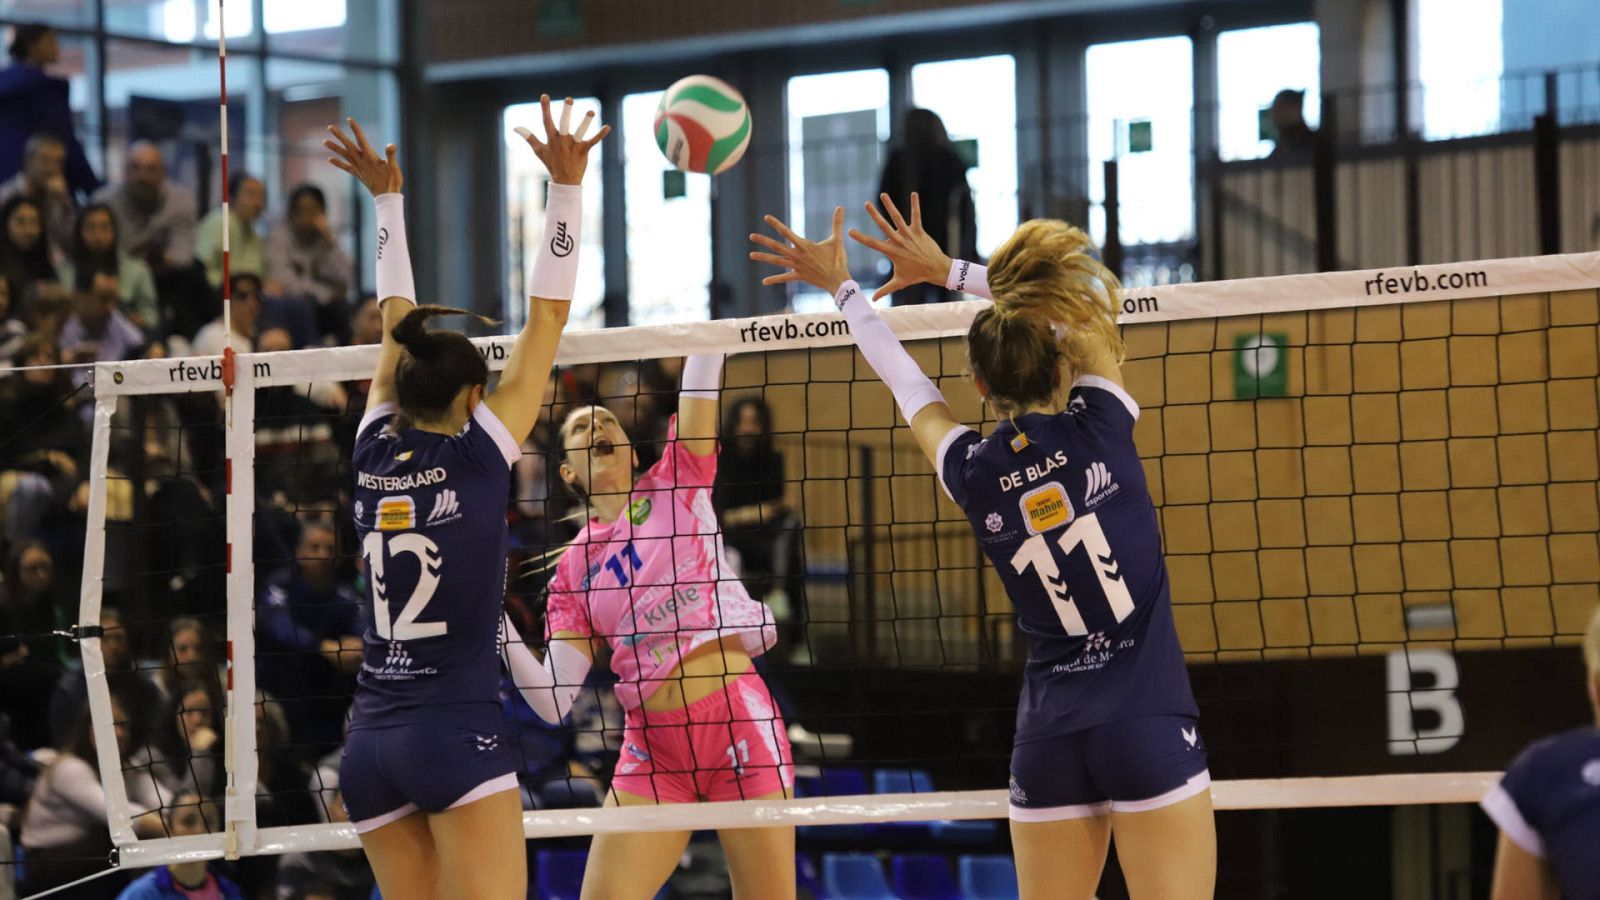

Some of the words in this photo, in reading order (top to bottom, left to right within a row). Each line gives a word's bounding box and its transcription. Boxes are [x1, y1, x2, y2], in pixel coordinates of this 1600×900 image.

[1365, 270, 1487, 295] rfevb.com
[740, 319, 850, 343] rfevb.com
[358, 467, 447, 491] WESTERGAARD
[999, 470, 1024, 493] DE
[1026, 450, 1069, 483] BLAS
[605, 540, 643, 588] 11
[1010, 512, 1136, 637] 11
[363, 531, 448, 641] 12
[1385, 648, 1465, 755] B
[726, 739, 750, 767] 11
